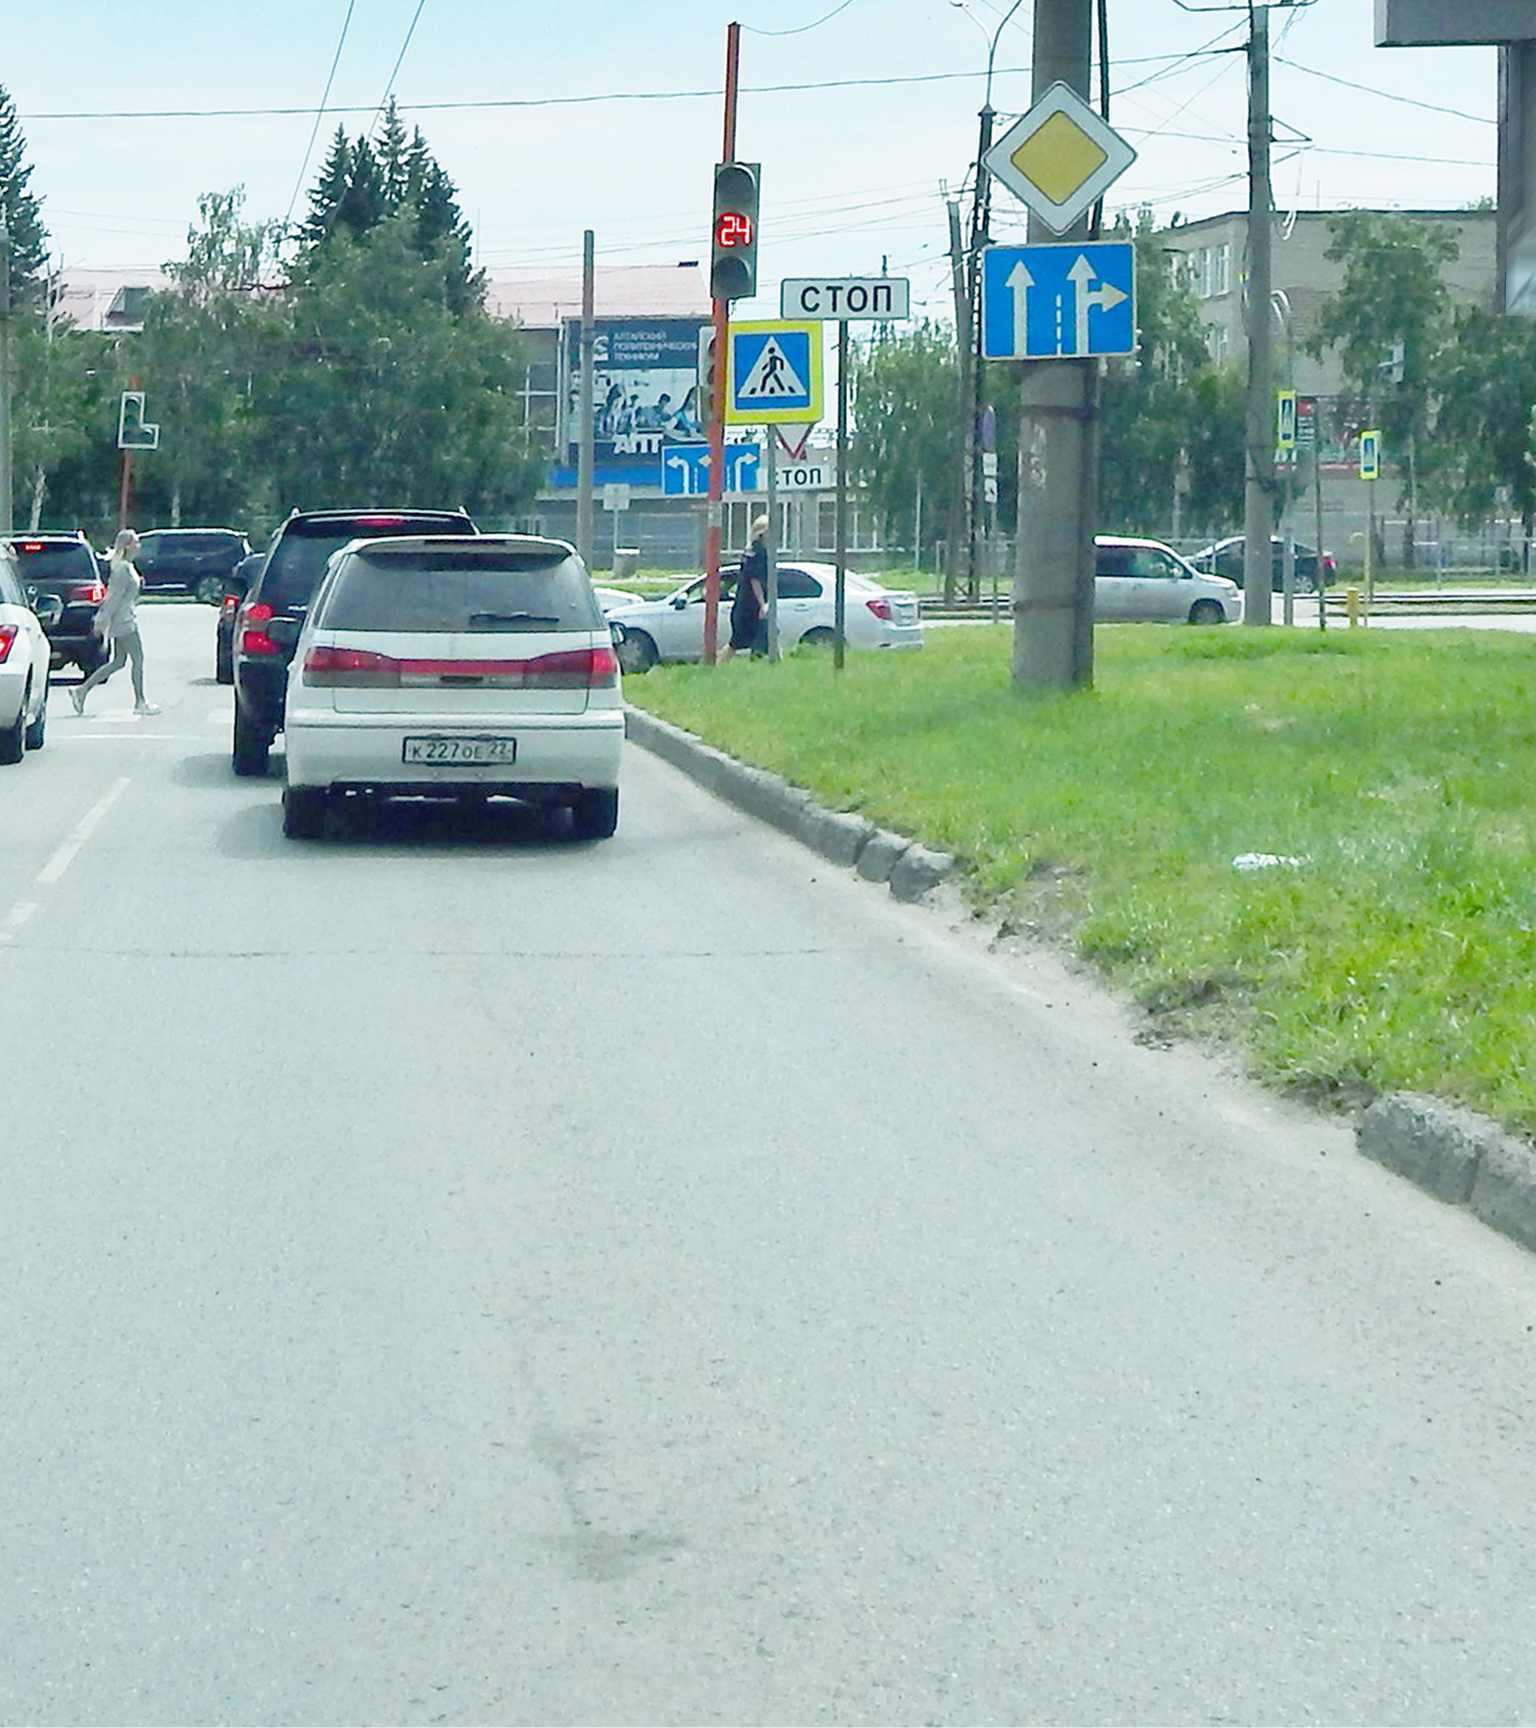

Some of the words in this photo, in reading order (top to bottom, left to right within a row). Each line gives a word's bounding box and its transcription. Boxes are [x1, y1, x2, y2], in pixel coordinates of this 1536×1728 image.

[721, 215, 751, 245] 24
[801, 285, 892, 313] СТОП
[776, 468, 822, 486] ТОП
